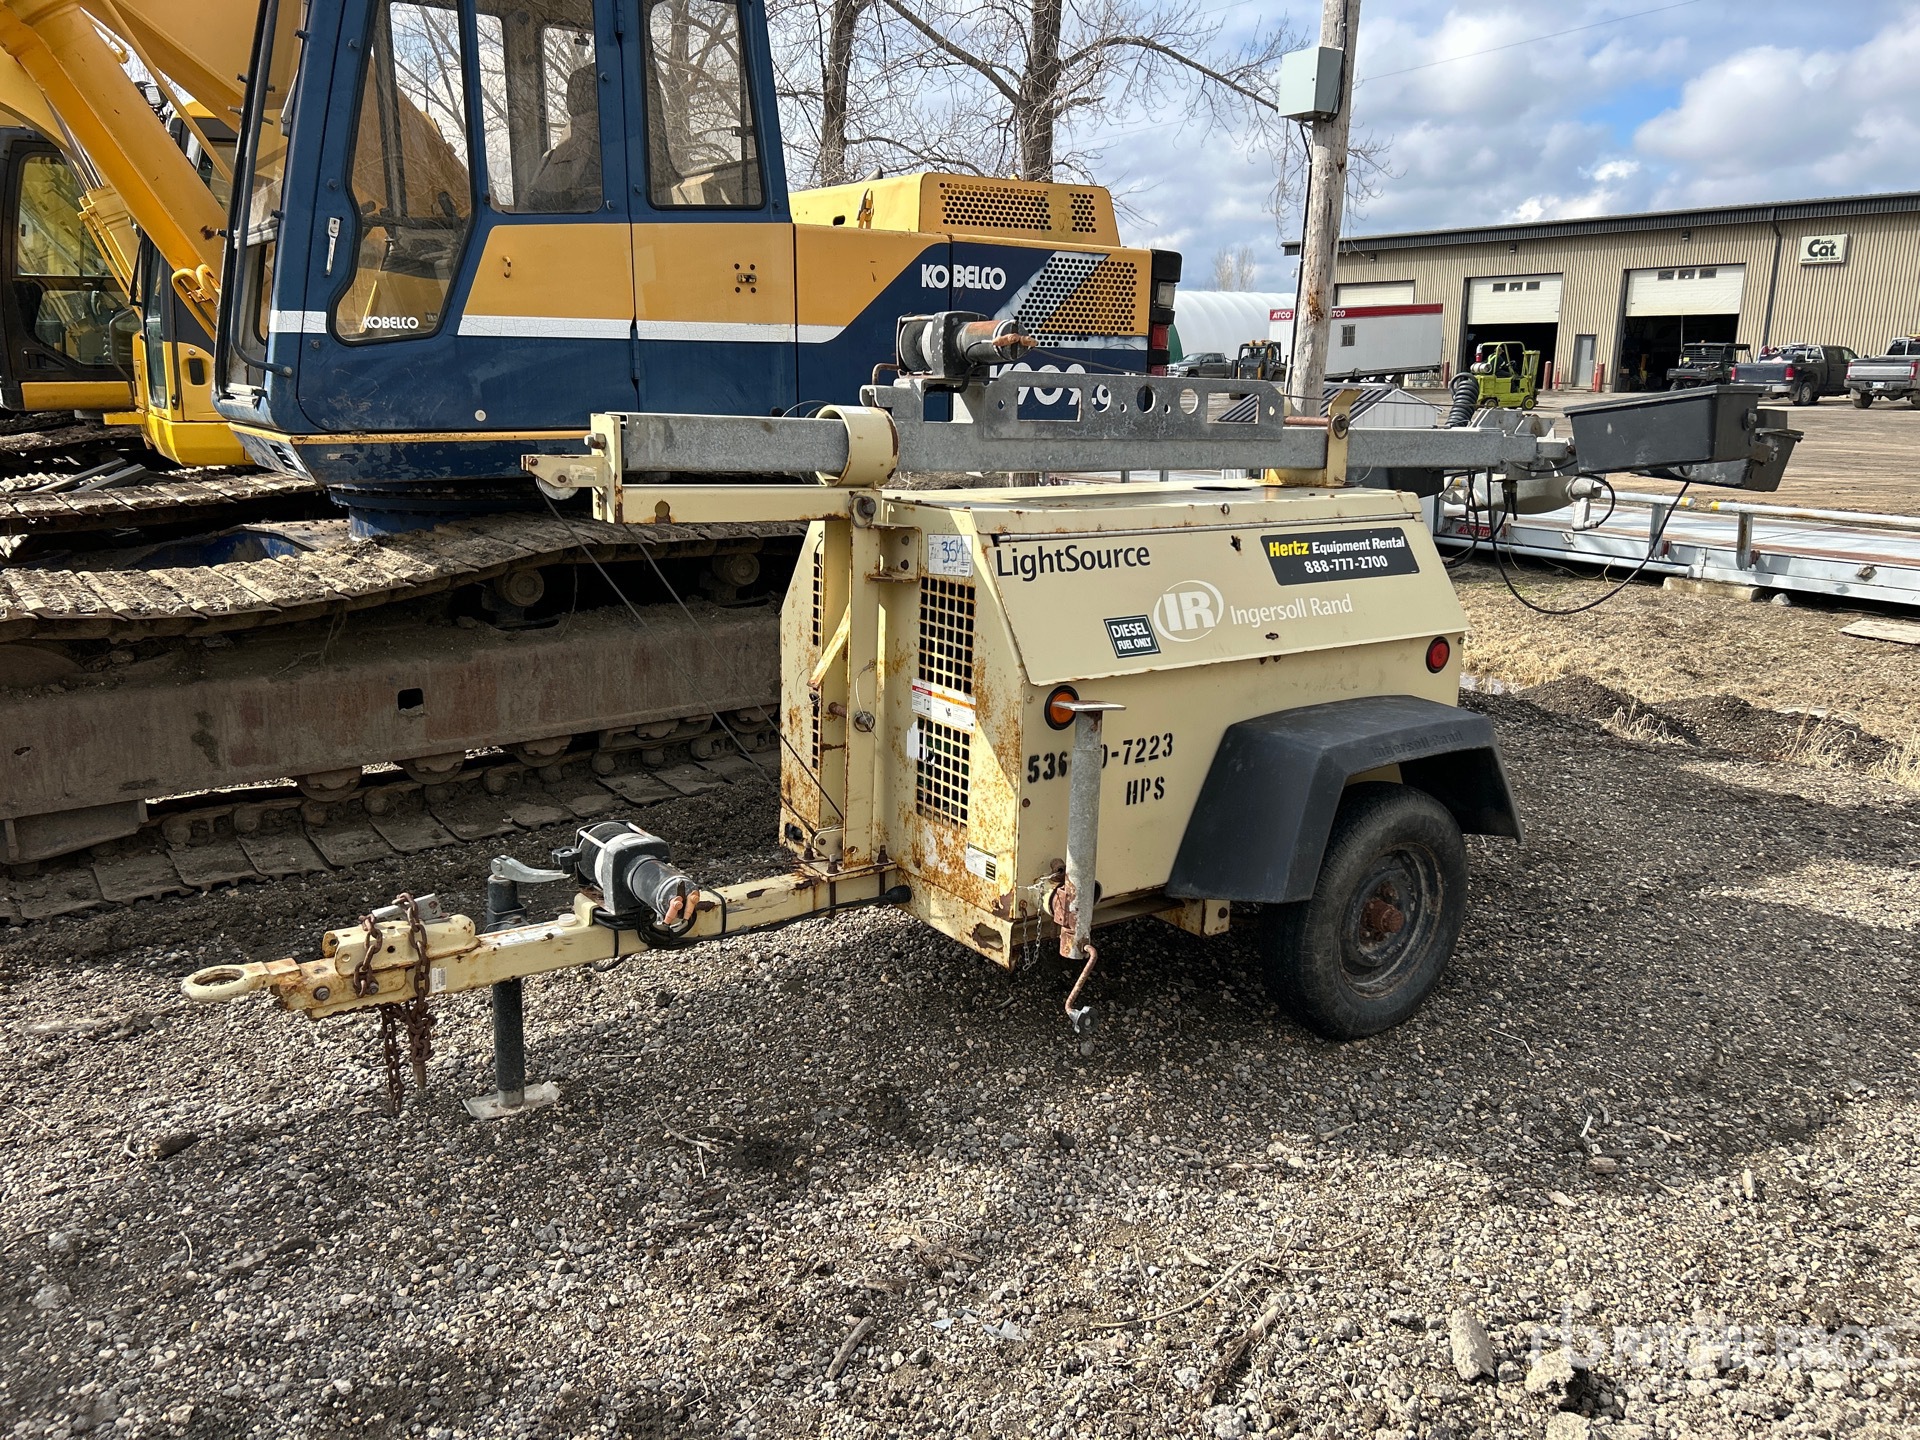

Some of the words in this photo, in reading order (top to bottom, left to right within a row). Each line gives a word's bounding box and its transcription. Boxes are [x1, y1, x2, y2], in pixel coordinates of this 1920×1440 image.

[1807, 238, 1837, 257] Cat
[921, 263, 1007, 291] KOBELCO
[364, 315, 419, 330] KOBELCO
[1272, 311, 1291, 320] ATCO
[1330, 309, 1346, 318] TCO
[1269, 540, 1310, 557] Hertz
[1312, 539, 1371, 556] Equipment
[1372, 535, 1406, 550] Rental
[996, 544, 1151, 582] LightSource
[1304, 554, 1389, 574] 888-777-2700
[1162, 590, 1216, 632] IR
[1230, 597, 1308, 629] Ingersoll
[1311, 593, 1353, 617] Rand
[1110, 622, 1149, 638] DIESEL
[1116, 639, 1135, 650] FUEL
[1133, 637, 1152, 649] ONLY
[1125, 776, 1165, 806] HPS
